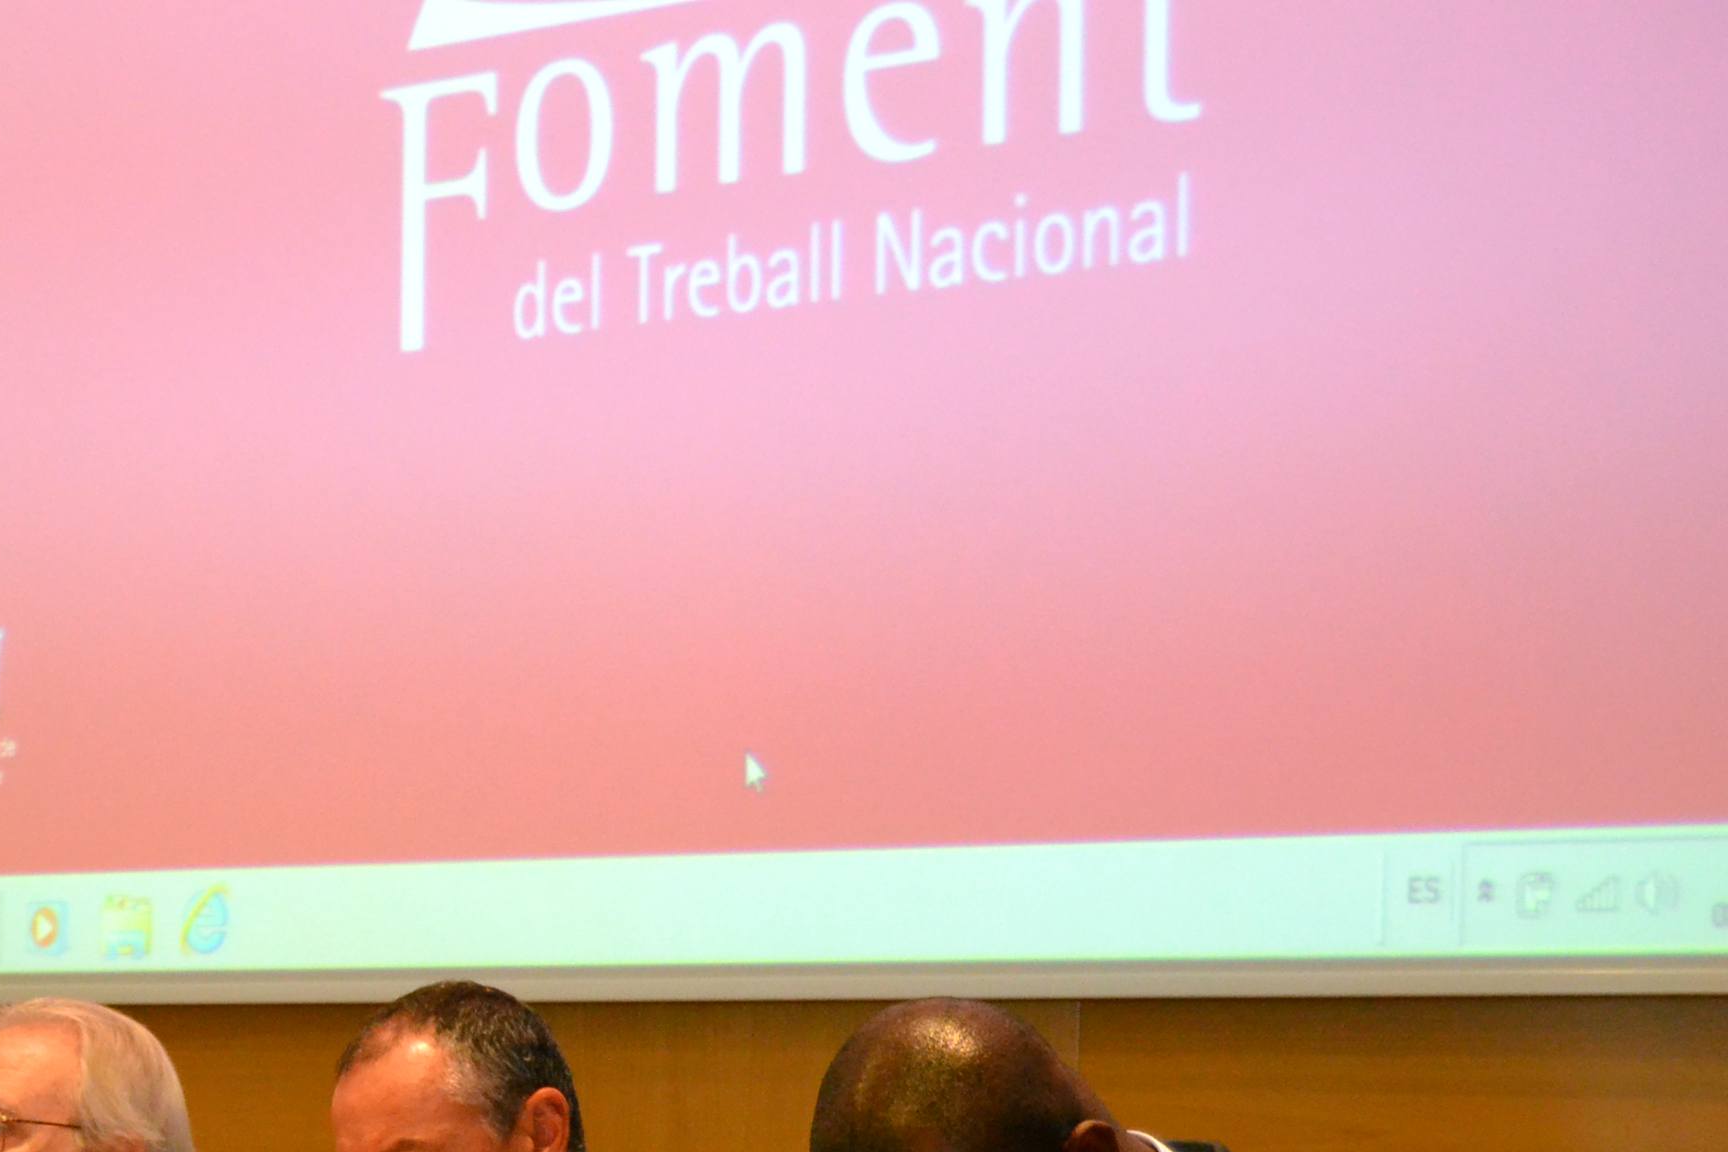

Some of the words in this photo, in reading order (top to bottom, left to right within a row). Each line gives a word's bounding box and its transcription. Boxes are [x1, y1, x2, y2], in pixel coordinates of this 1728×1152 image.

[512, 252, 602, 339] del
[627, 219, 842, 324] Treball
[874, 172, 1191, 296] Nacional
[1407, 876, 1441, 904] ES
